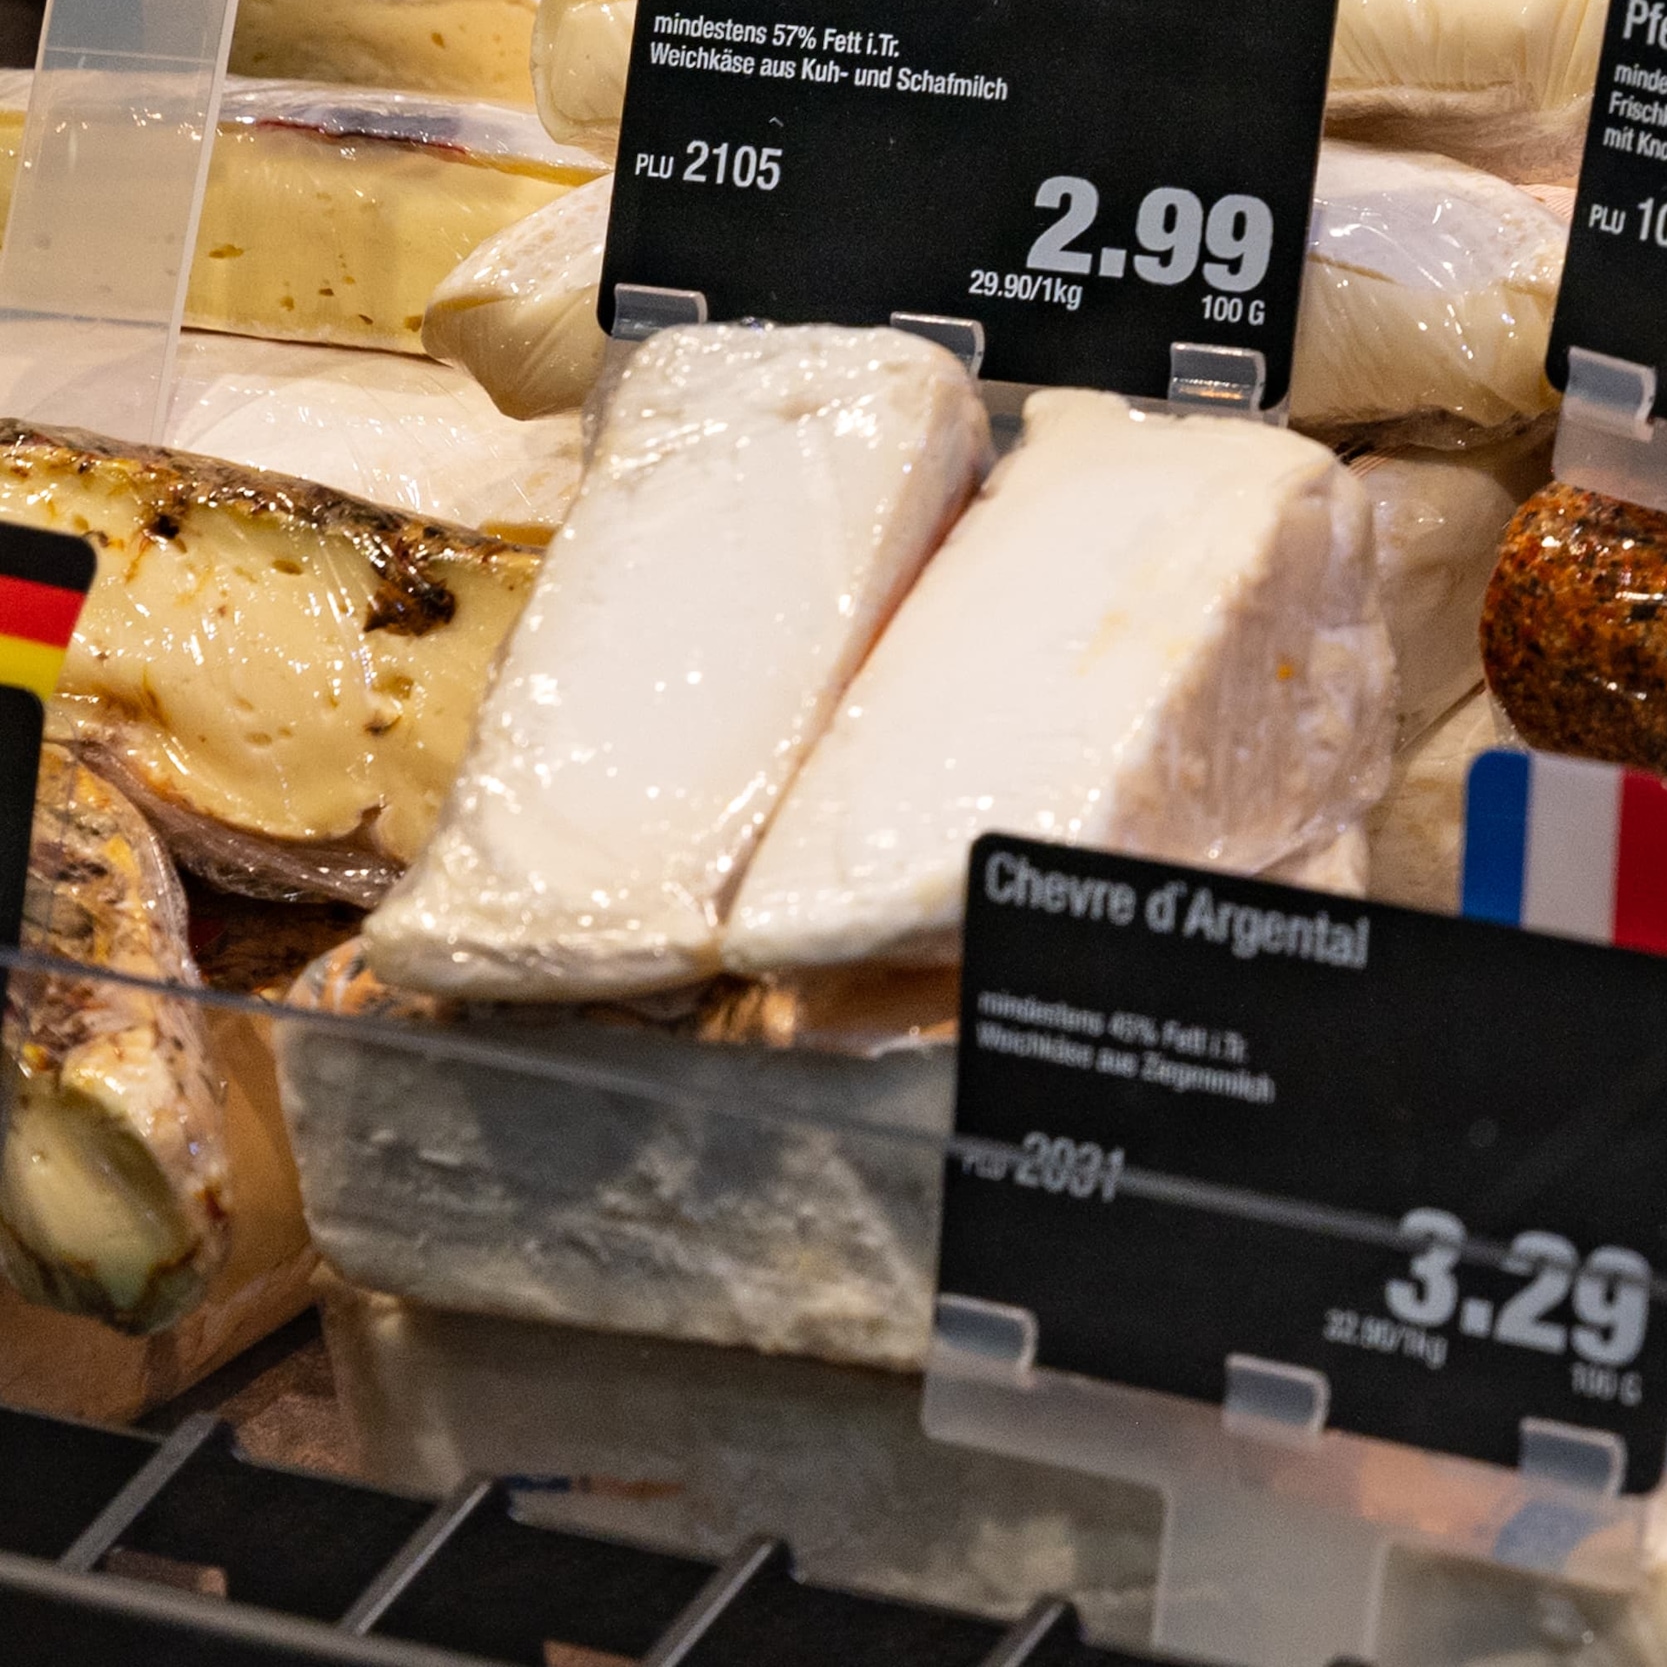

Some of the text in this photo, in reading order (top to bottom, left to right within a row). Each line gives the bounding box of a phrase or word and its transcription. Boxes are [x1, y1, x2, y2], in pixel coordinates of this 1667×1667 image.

[653, 11, 900, 58] mindestens 57% Fett i.Tr.
[649, 40, 1009, 101] Weichkäse aus Kuh- und Schafmilch
[1602, 125, 1635, 152] mit
[634, 139, 783, 191] PLU 2105
[1025, 174, 1274, 293] 2.99
[1587, 203, 1627, 235] PLU
[967, 268, 1083, 311] 29.90/1kg
[1200, 293, 1265, 326] 100 G
[984, 851, 1137, 926] Chevre
[1385, 1207, 1649, 1365] 3.29
